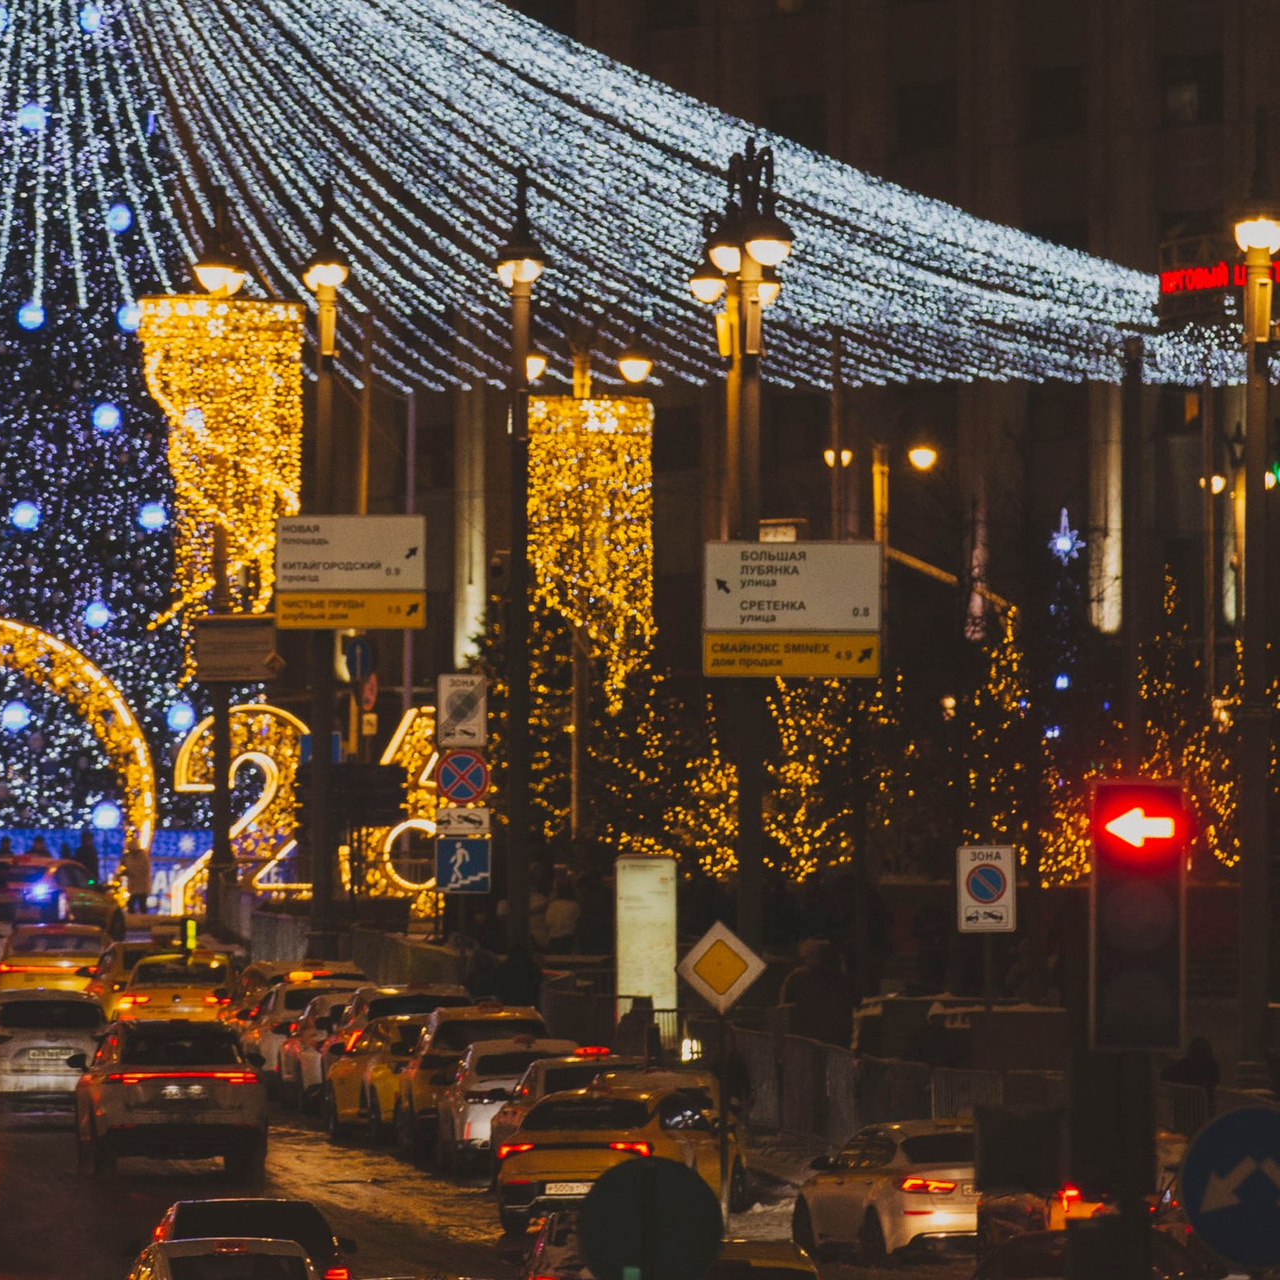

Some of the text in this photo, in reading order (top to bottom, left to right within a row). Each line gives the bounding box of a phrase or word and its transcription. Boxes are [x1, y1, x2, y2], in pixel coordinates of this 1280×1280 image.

[281, 524, 320, 534] НОВАЯ
[281, 537, 329, 547] площадь
[740, 550, 807, 562] БОЛЬШАЯ
[281, 561, 382, 571] КИТАЙГОРОДСКИЙ
[739, 565, 800, 576] ЛУБЯНКА
[281, 574, 319, 584] проезд
[739, 578, 778, 590] улица
[739, 600, 807, 611] СРЕТЕНКА
[739, 613, 777, 625] улица
[711, 642, 831, 654] СМАЙНЭКС SMINEX
[710, 658, 783, 669] дом продаж
[970, 851, 1002, 861] ЗОНА
